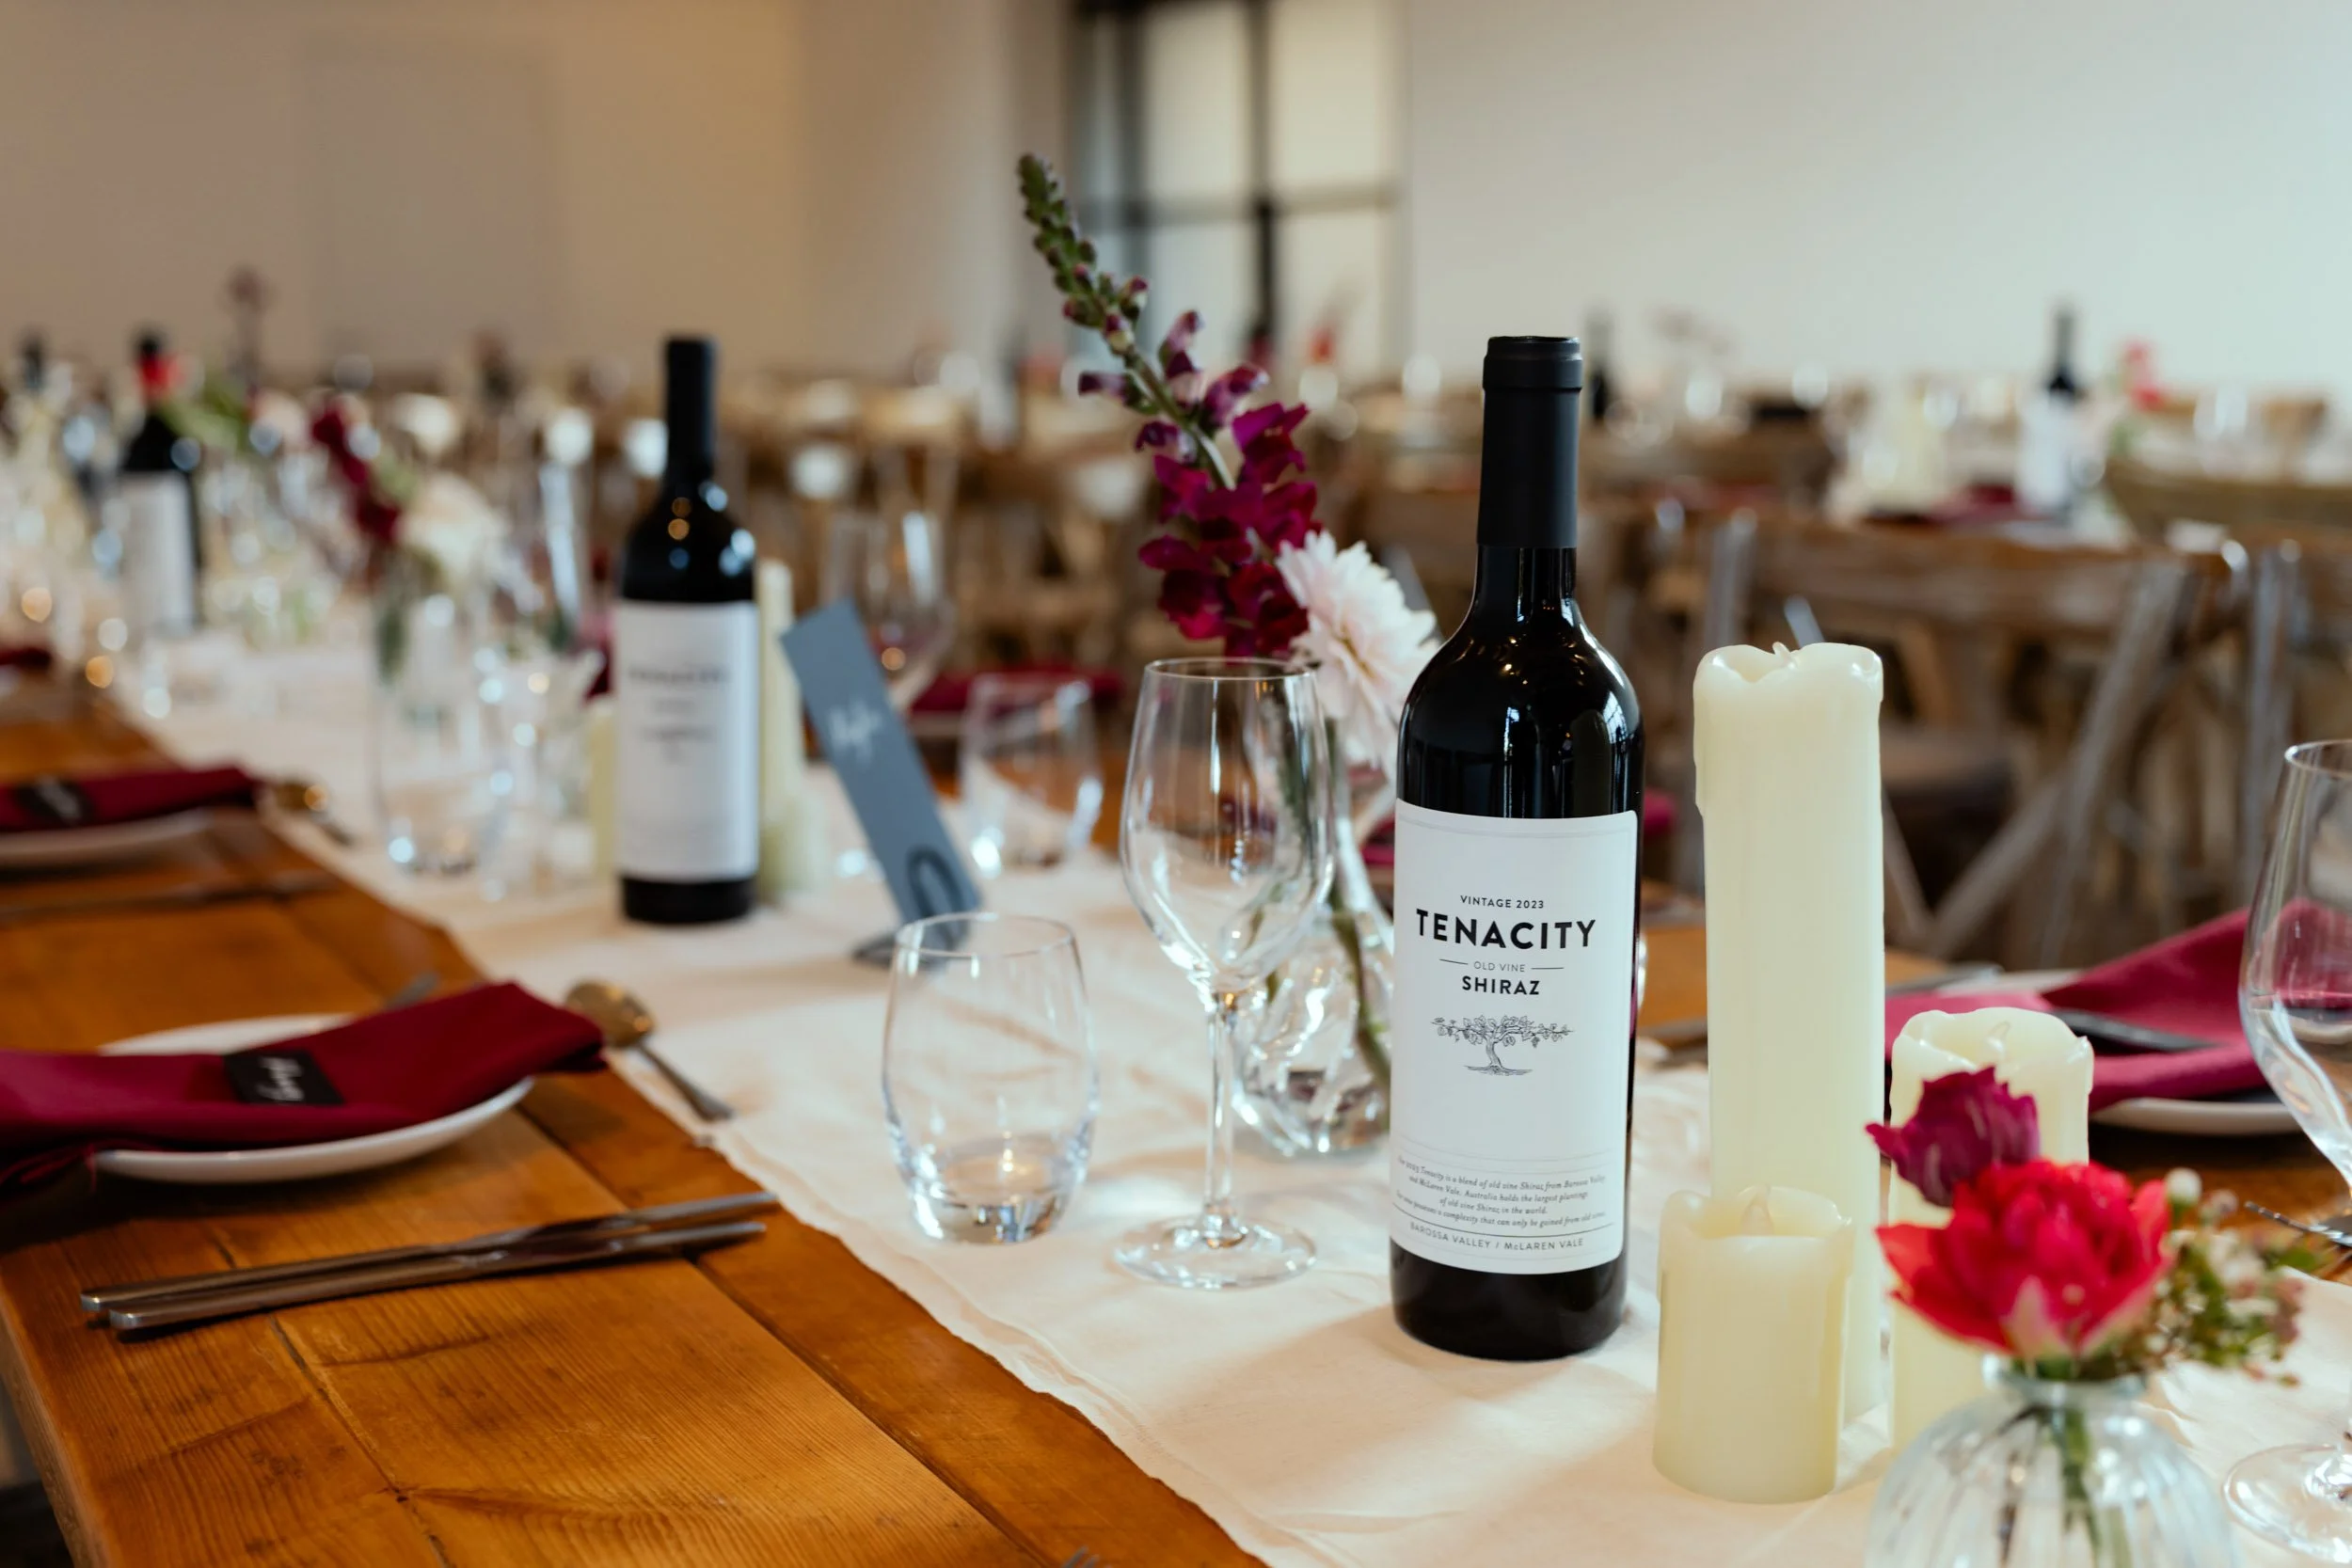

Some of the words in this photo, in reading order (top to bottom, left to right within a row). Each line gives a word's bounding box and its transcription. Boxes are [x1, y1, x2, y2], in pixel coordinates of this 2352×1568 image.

[1460, 895, 1512, 909] VINTAGE
[1517, 899, 1545, 909] 2023
[1416, 909, 1596, 950] TENACITY
[1473, 960, 1496, 971] OLD
[1500, 962, 1526, 973] VINE
[1462, 975, 1540, 995] SHIRAZ
[1421, 1166, 1444, 1181] Tenacity
[1458, 1176, 1478, 1186] blend
[1479, 1180, 1488, 1189] of
[1488, 1180, 1501, 1189] old
[1520, 1181, 1543, 1191] Shiraz
[1543, 1181, 1562, 1192] from
[1419, 1178, 1443, 1191] McLaren
[1464, 1190, 1498, 1200] Australia
[1500, 1193, 1518, 1202] holds
[1520, 1193, 1532, 1202] the
[1534, 1194, 1558, 1204] largest
[1439, 1196, 1447, 1208] of
[1447, 1199, 1458, 1208] old
[1476, 1203, 1500, 1214] Shiraz
[1525, 1206, 1549, 1214] world.
[1443, 1212, 1478, 1225] complexity
[1480, 1215, 1495, 1225] that
[1511, 1219, 1528, 1228] only
[1539, 1217, 1563, 1228] gained
[1564, 1215, 1581, 1227] from
[1409, 1222, 1449, 1242] BAROSSA
[1452, 1235, 1490, 1249] VALLEY
[1504, 1242, 1555, 1251] McLAREN
[1558, 1238, 1583, 1249] VALE
